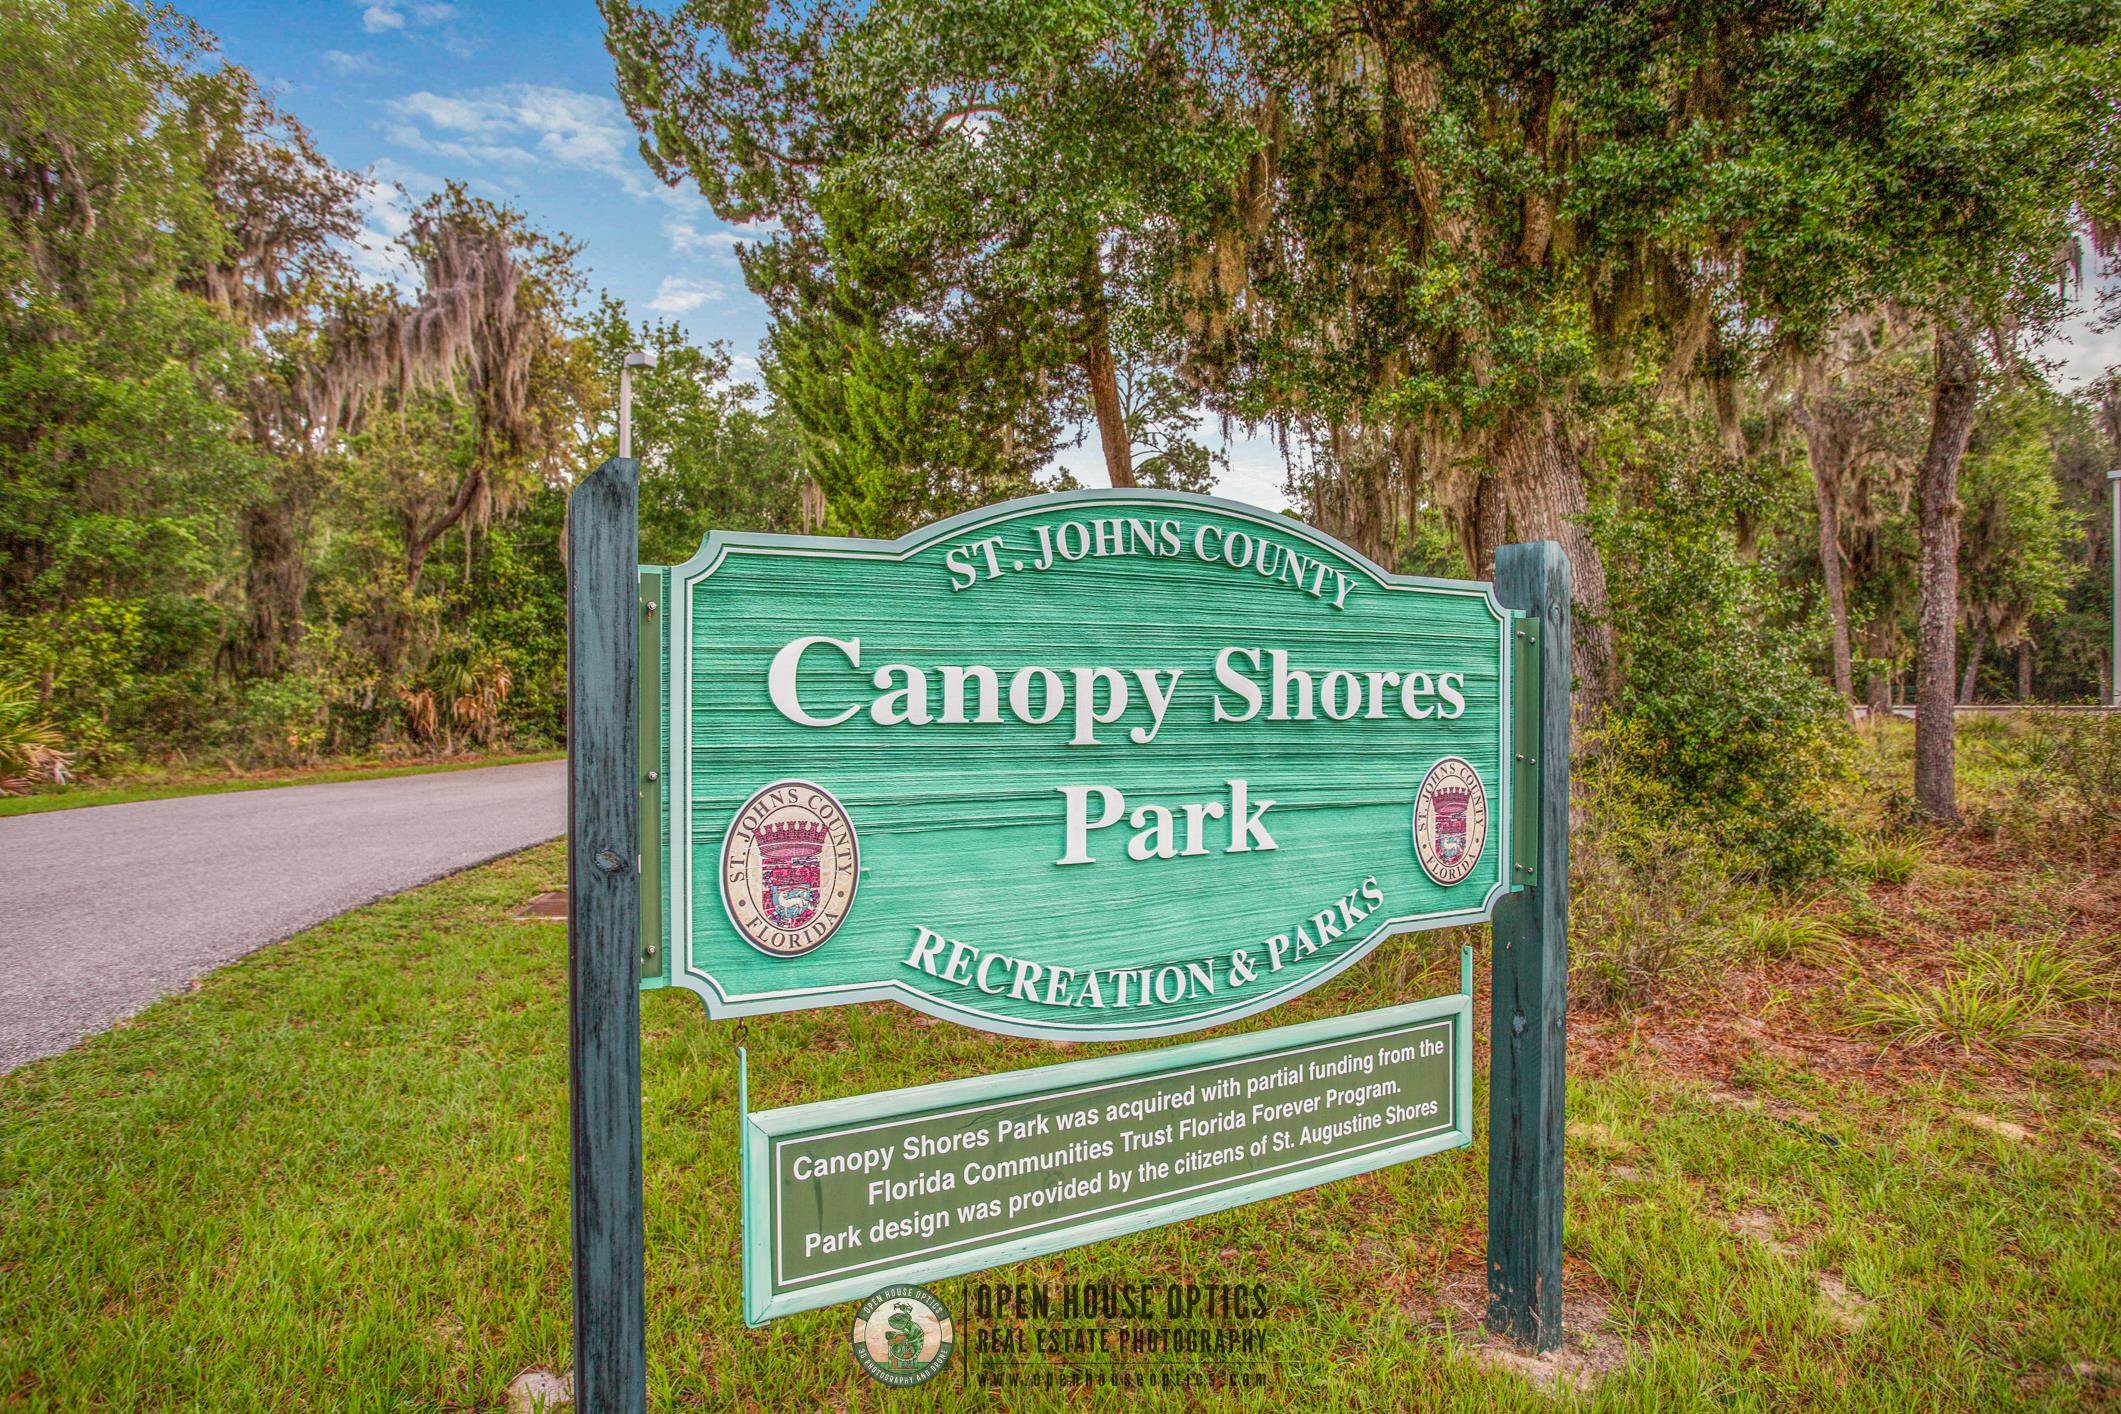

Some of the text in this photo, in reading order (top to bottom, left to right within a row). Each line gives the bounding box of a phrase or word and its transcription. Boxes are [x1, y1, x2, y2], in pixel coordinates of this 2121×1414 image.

[945, 518, 1359, 610] ST. JOHNS COUNTY
[767, 635, 1466, 745] Canopy Shores
[730, 788, 853, 883] ST. JOHNS COUNTY
[1056, 780, 1279, 866] Park
[1422, 763, 1456, 803] JOHNS
[1460, 767, 1484, 828] COUNTY
[1426, 854, 1476, 880] FLORIDA
[745, 912, 839, 949] FLORIDA
[903, 876, 1386, 1009] RECREATION & PARKS
[793, 1038, 1444, 1181] Canopy Shores Park was acquired with partial funding from the
[868, 1077, 1402, 1205] Florida Communities Trust Florida Forever Program.
[805, 1098, 1438, 1258] Park design was provided by the citizens of St. Augustine Shores
